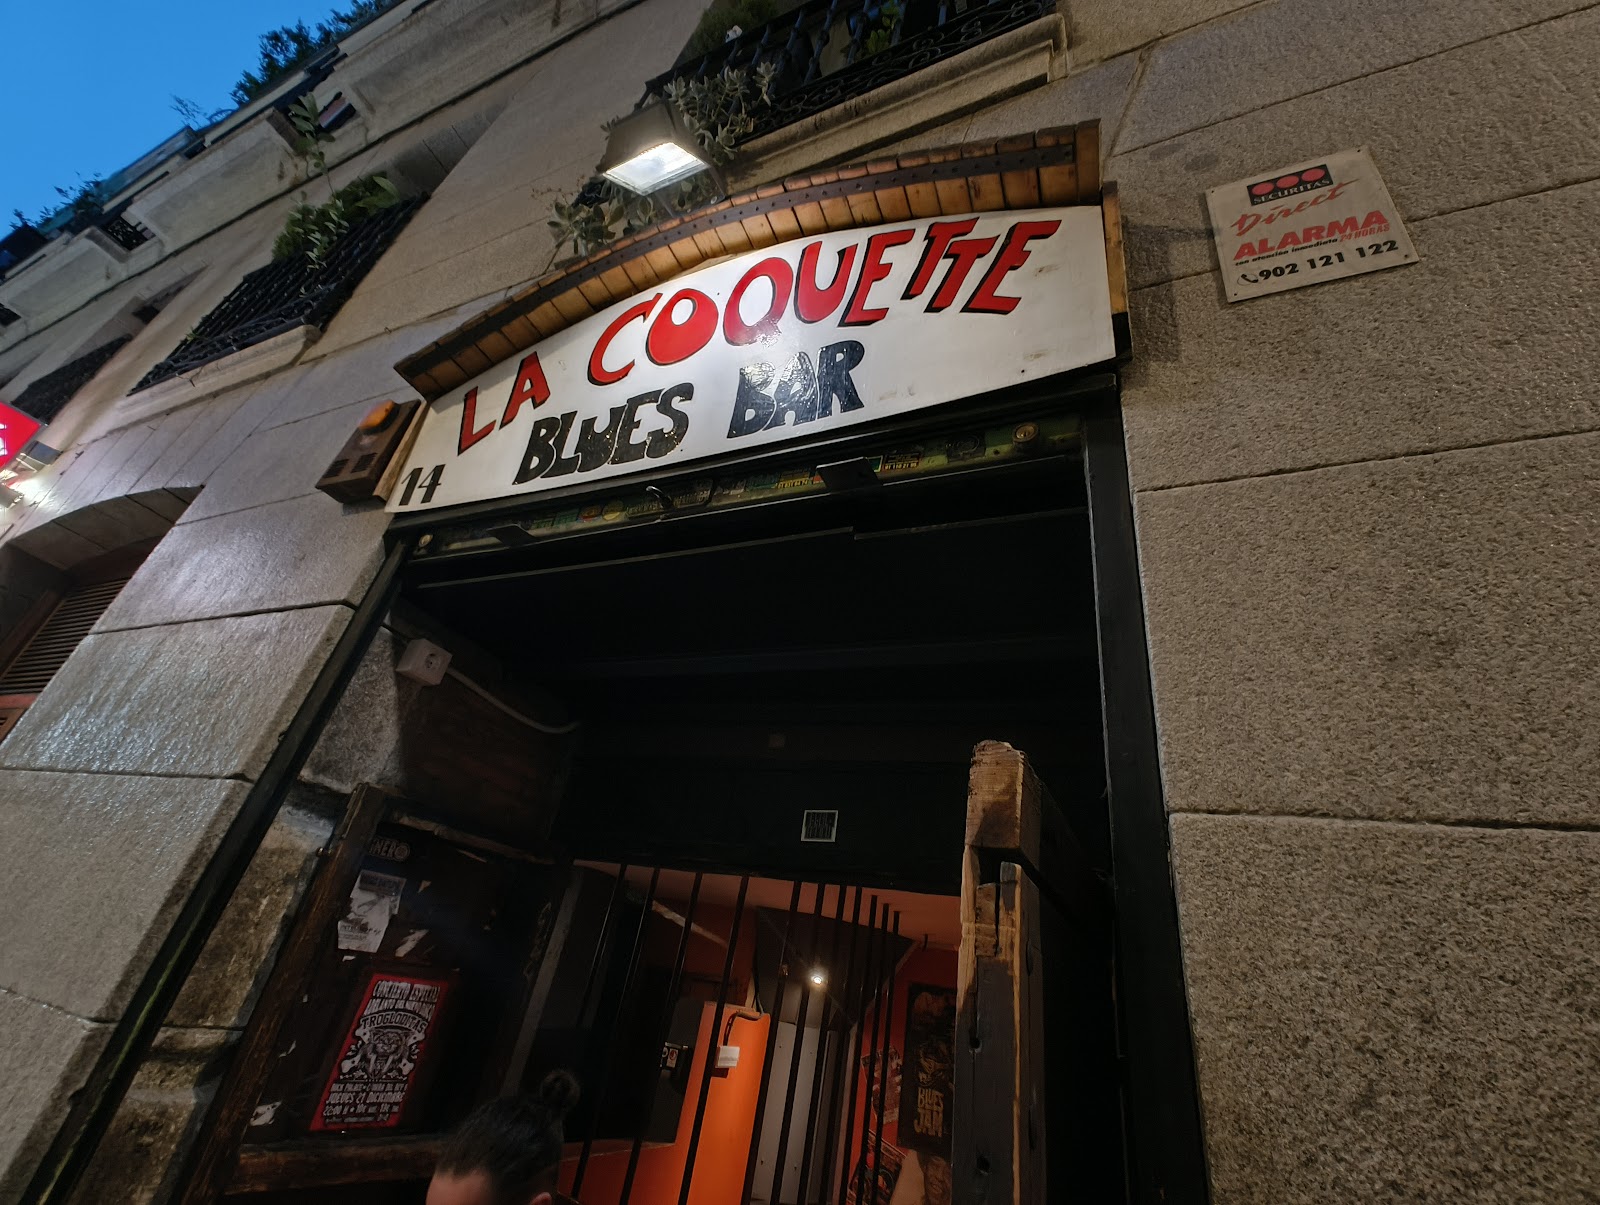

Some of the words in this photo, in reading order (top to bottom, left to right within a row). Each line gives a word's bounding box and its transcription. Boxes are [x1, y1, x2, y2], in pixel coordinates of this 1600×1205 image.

[1230, 178, 1359, 237] Direct
[1253, 178, 1332, 206] SECURITAS
[1233, 210, 1389, 260] ALARMA
[1353, 223, 1390, 239] HORAS
[1258, 263, 1299, 281] 902
[1306, 252, 1345, 270] 121
[1355, 239, 1399, 259] 122
[458, 352, 550, 455] LA
[588, 217, 1062, 386] COQUETTE
[513, 381, 695, 485] BLUES
[725, 339, 866, 439] BAR
[399, 463, 444, 505] 14
[361, 1012, 428, 1034] TROGLODITAS
[326, 1091, 356, 1104] JUEVES
[917, 1087, 944, 1111] BLUES
[913, 1107, 944, 1137] JAM
